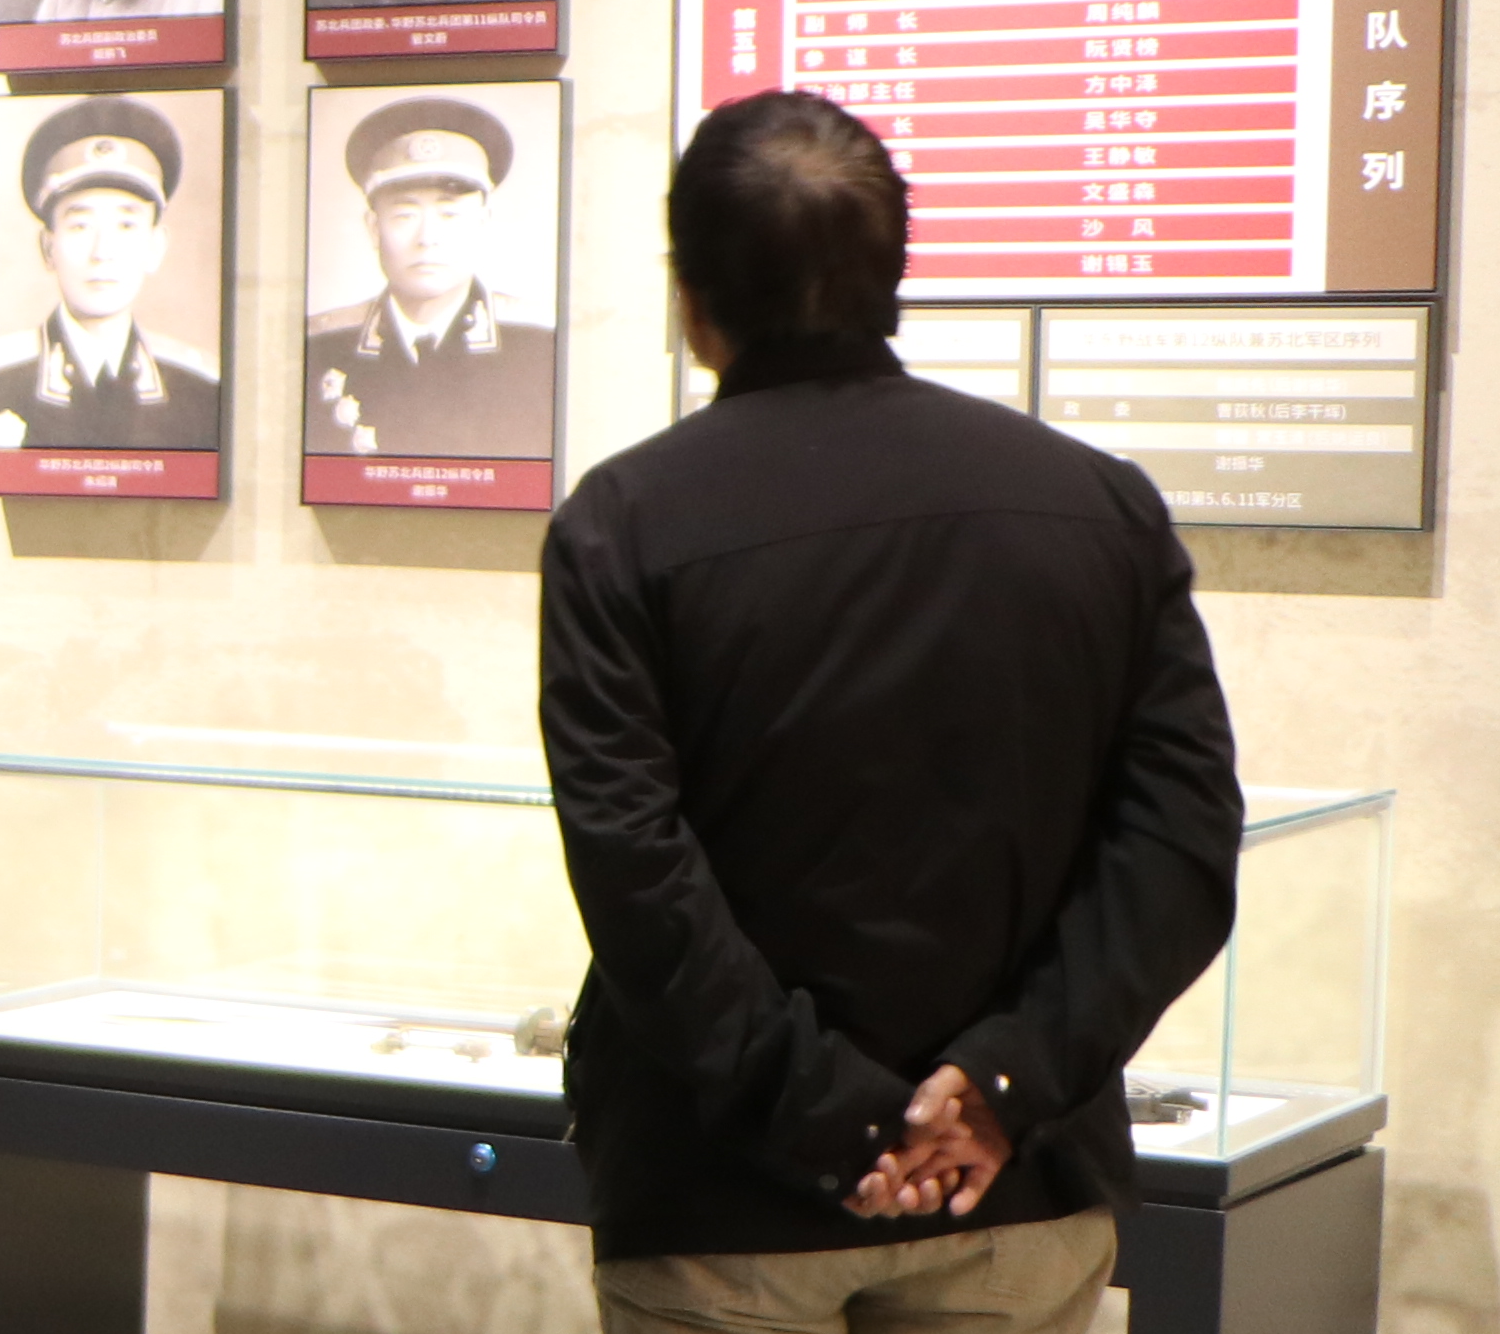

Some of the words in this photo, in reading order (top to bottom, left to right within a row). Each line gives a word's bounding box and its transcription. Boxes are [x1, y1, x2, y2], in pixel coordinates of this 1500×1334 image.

[804, 11, 918, 35] 副师长
[731, 7, 758, 75] 第五师
[804, 46, 918, 69] 参谋长
[1063, 400, 1131, 419] 政委
